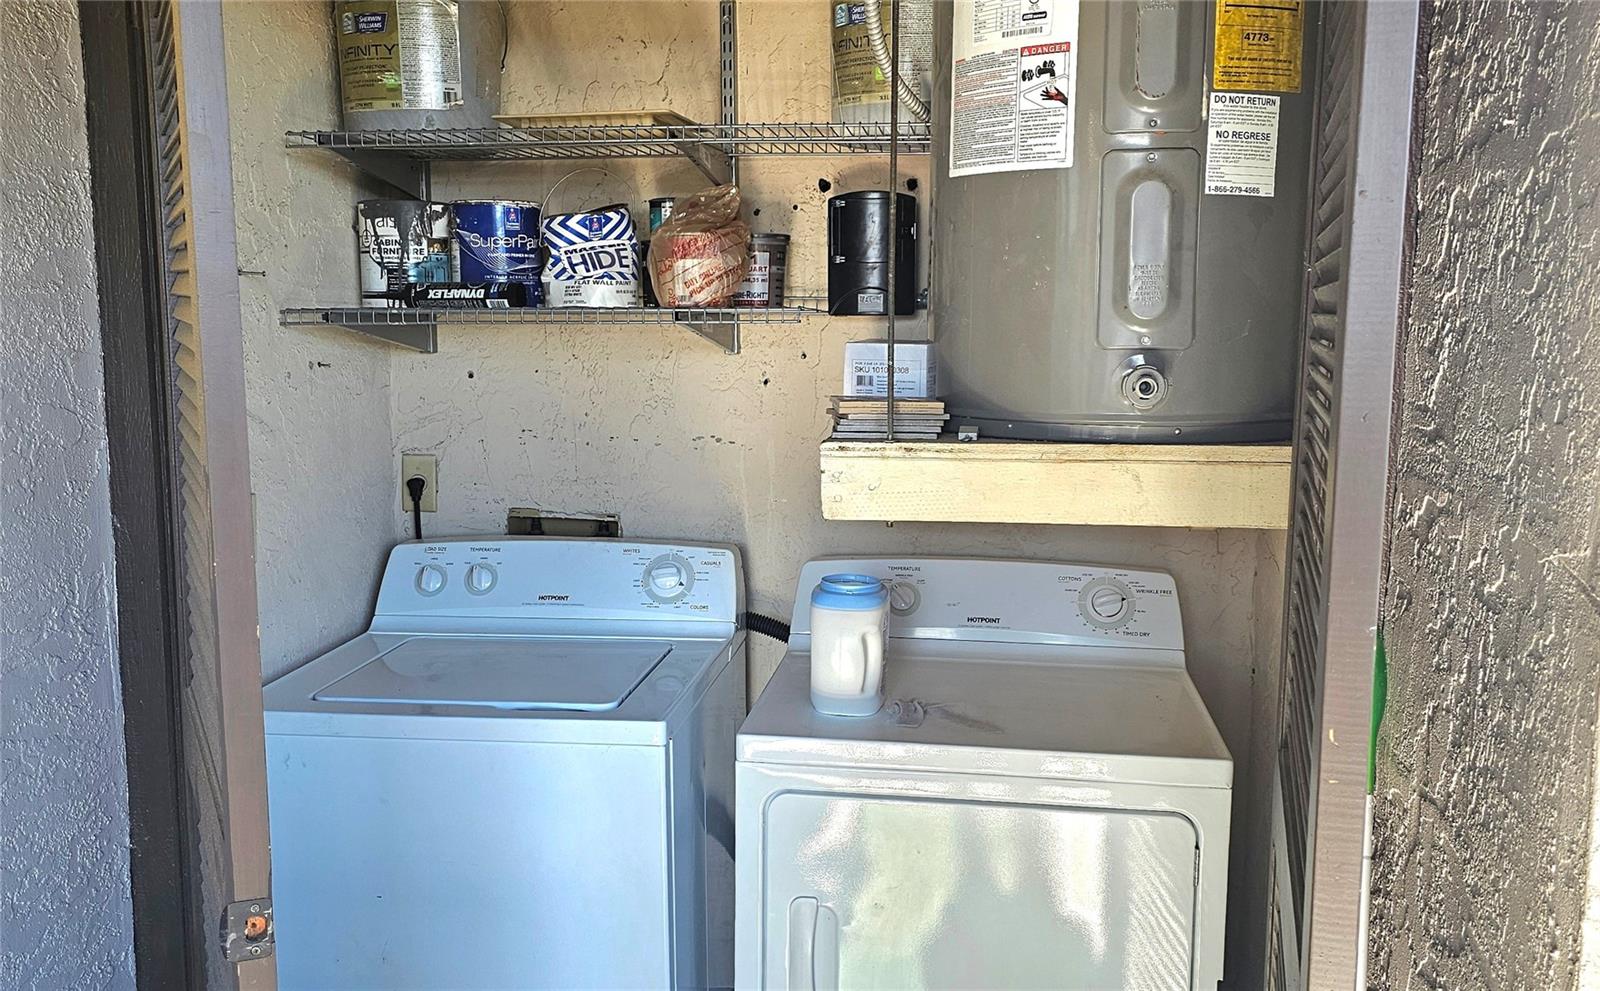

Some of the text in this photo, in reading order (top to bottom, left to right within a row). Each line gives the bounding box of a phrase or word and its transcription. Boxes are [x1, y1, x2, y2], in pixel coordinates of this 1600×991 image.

[358, 15, 382, 23] SHERWIN
[1244, 32, 1269, 42] 4773
[1032, 44, 1067, 54] DANGER
[1214, 95, 1277, 107] DO NOT RETURN
[1216, 130, 1271, 141] NO REGRESE
[470, 233, 541, 251] SuperPai
[567, 248, 631, 275] HIDE
[750, 254, 758, 265] 1
[427, 289, 485, 299] DYNAFLEX
